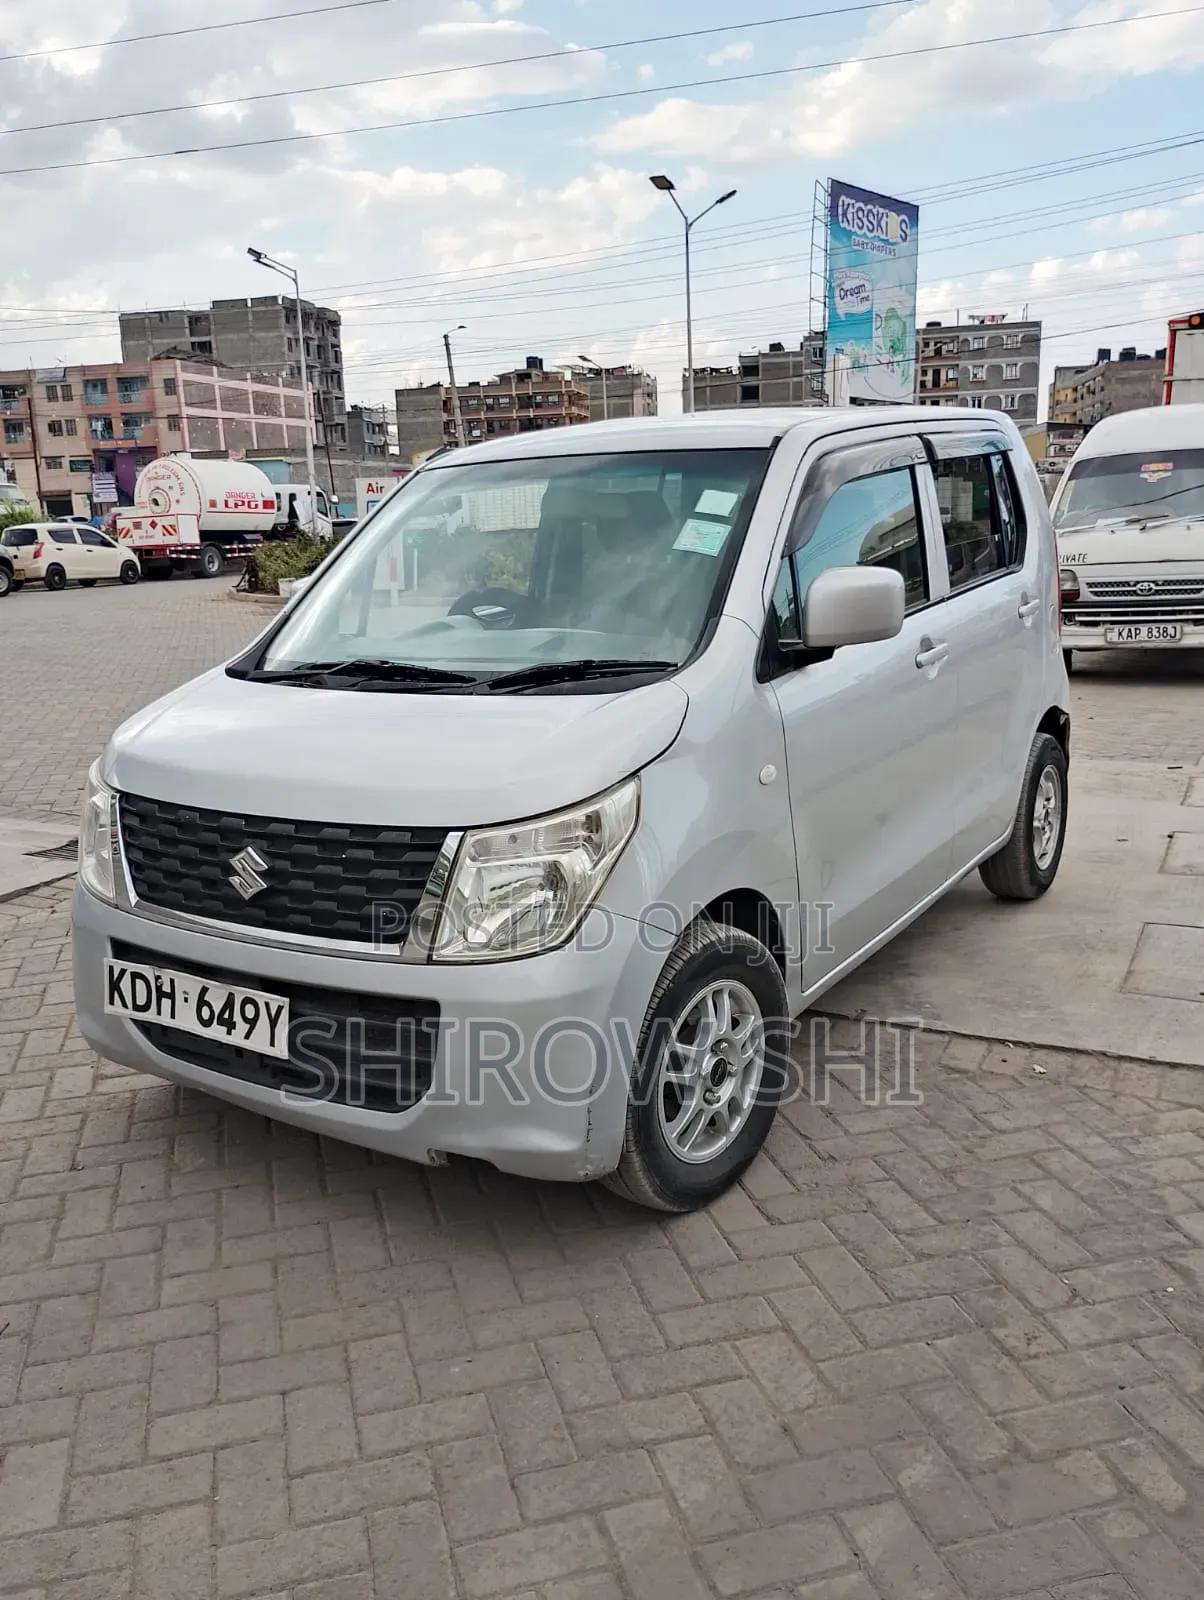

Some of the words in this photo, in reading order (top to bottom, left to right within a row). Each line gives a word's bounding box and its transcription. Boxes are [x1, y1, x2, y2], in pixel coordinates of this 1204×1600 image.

[839, 283, 866, 301] Dream
[225, 491, 256, 499] DANGER
[366, 481, 385, 495] Air
[223, 499, 259, 510] LPG
[1060, 552, 1088, 564] IVATE
[1117, 627, 1141, 641] KAP
[1146, 626, 1177, 640] 838J
[108, 964, 176, 1020] KDH
[195, 984, 285, 1048] 649Y
